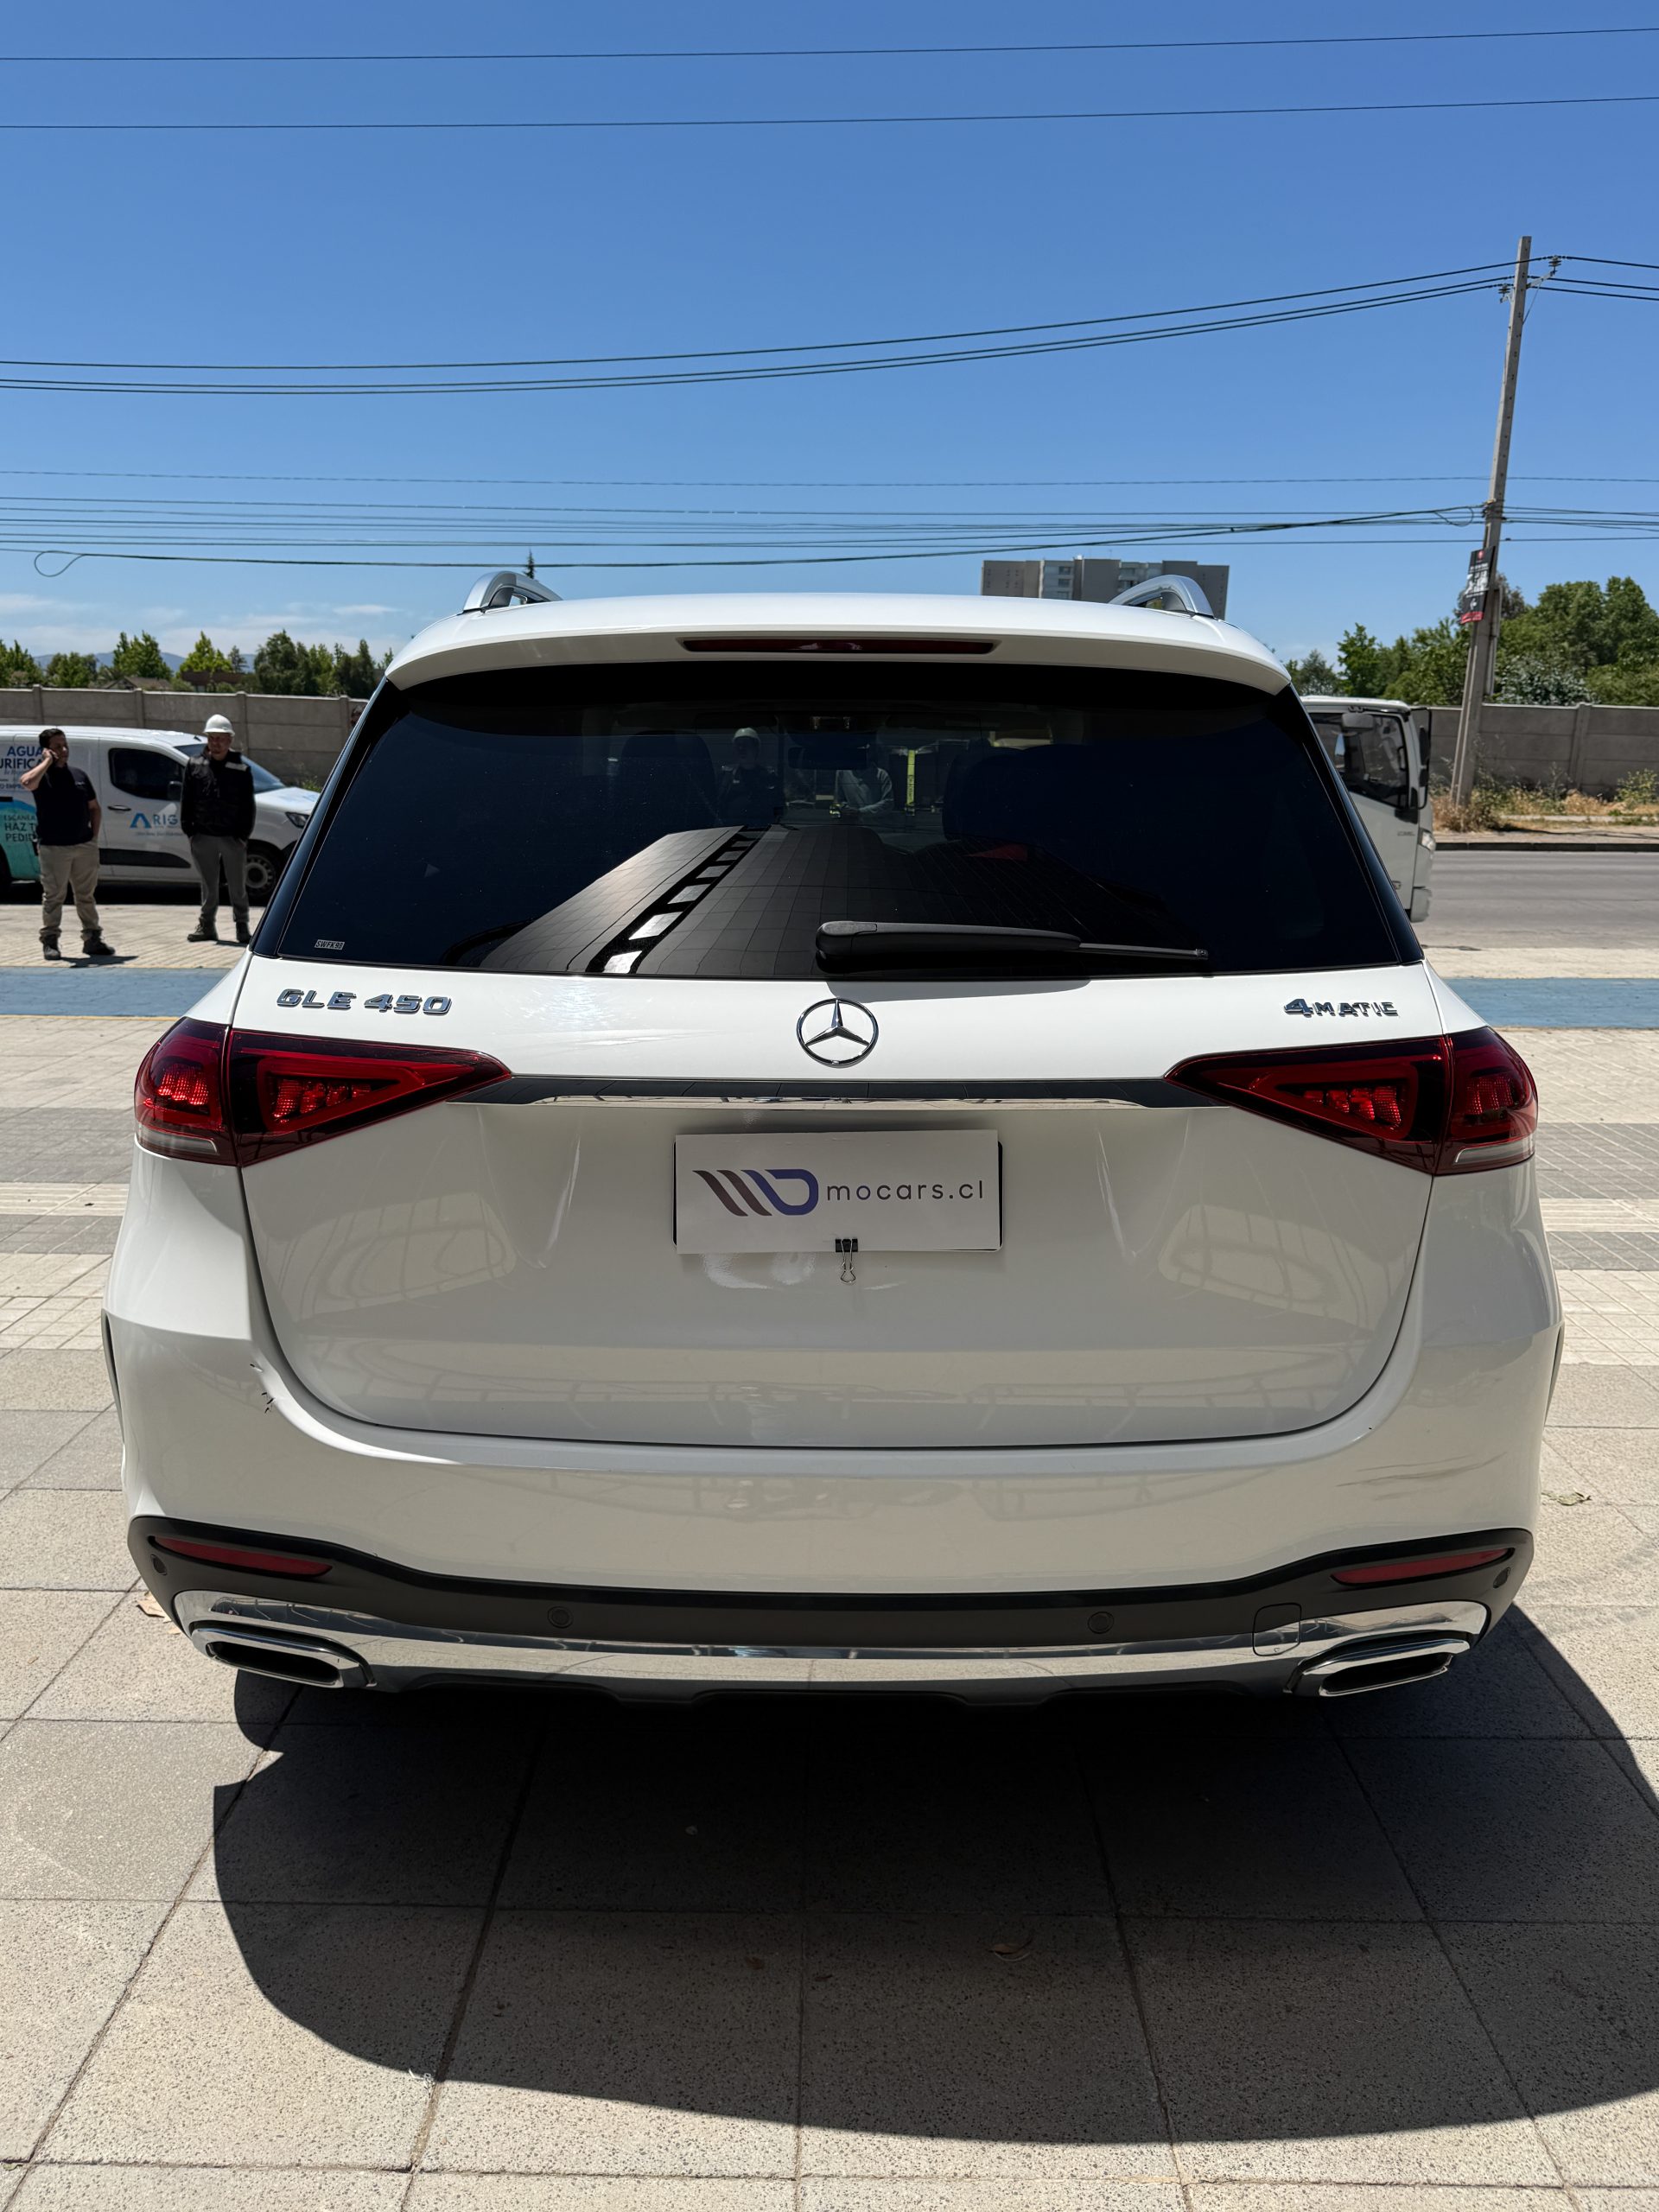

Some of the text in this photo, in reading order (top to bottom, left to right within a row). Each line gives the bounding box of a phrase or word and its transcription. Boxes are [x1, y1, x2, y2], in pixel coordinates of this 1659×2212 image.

[7, 746, 43, 757] AGUA
[4, 823, 27, 831] HAZ
[5, 833, 35, 842] PEDID
[276, 988, 453, 1016] GLE 450
[827, 1180, 983, 1201] mocars.cl
